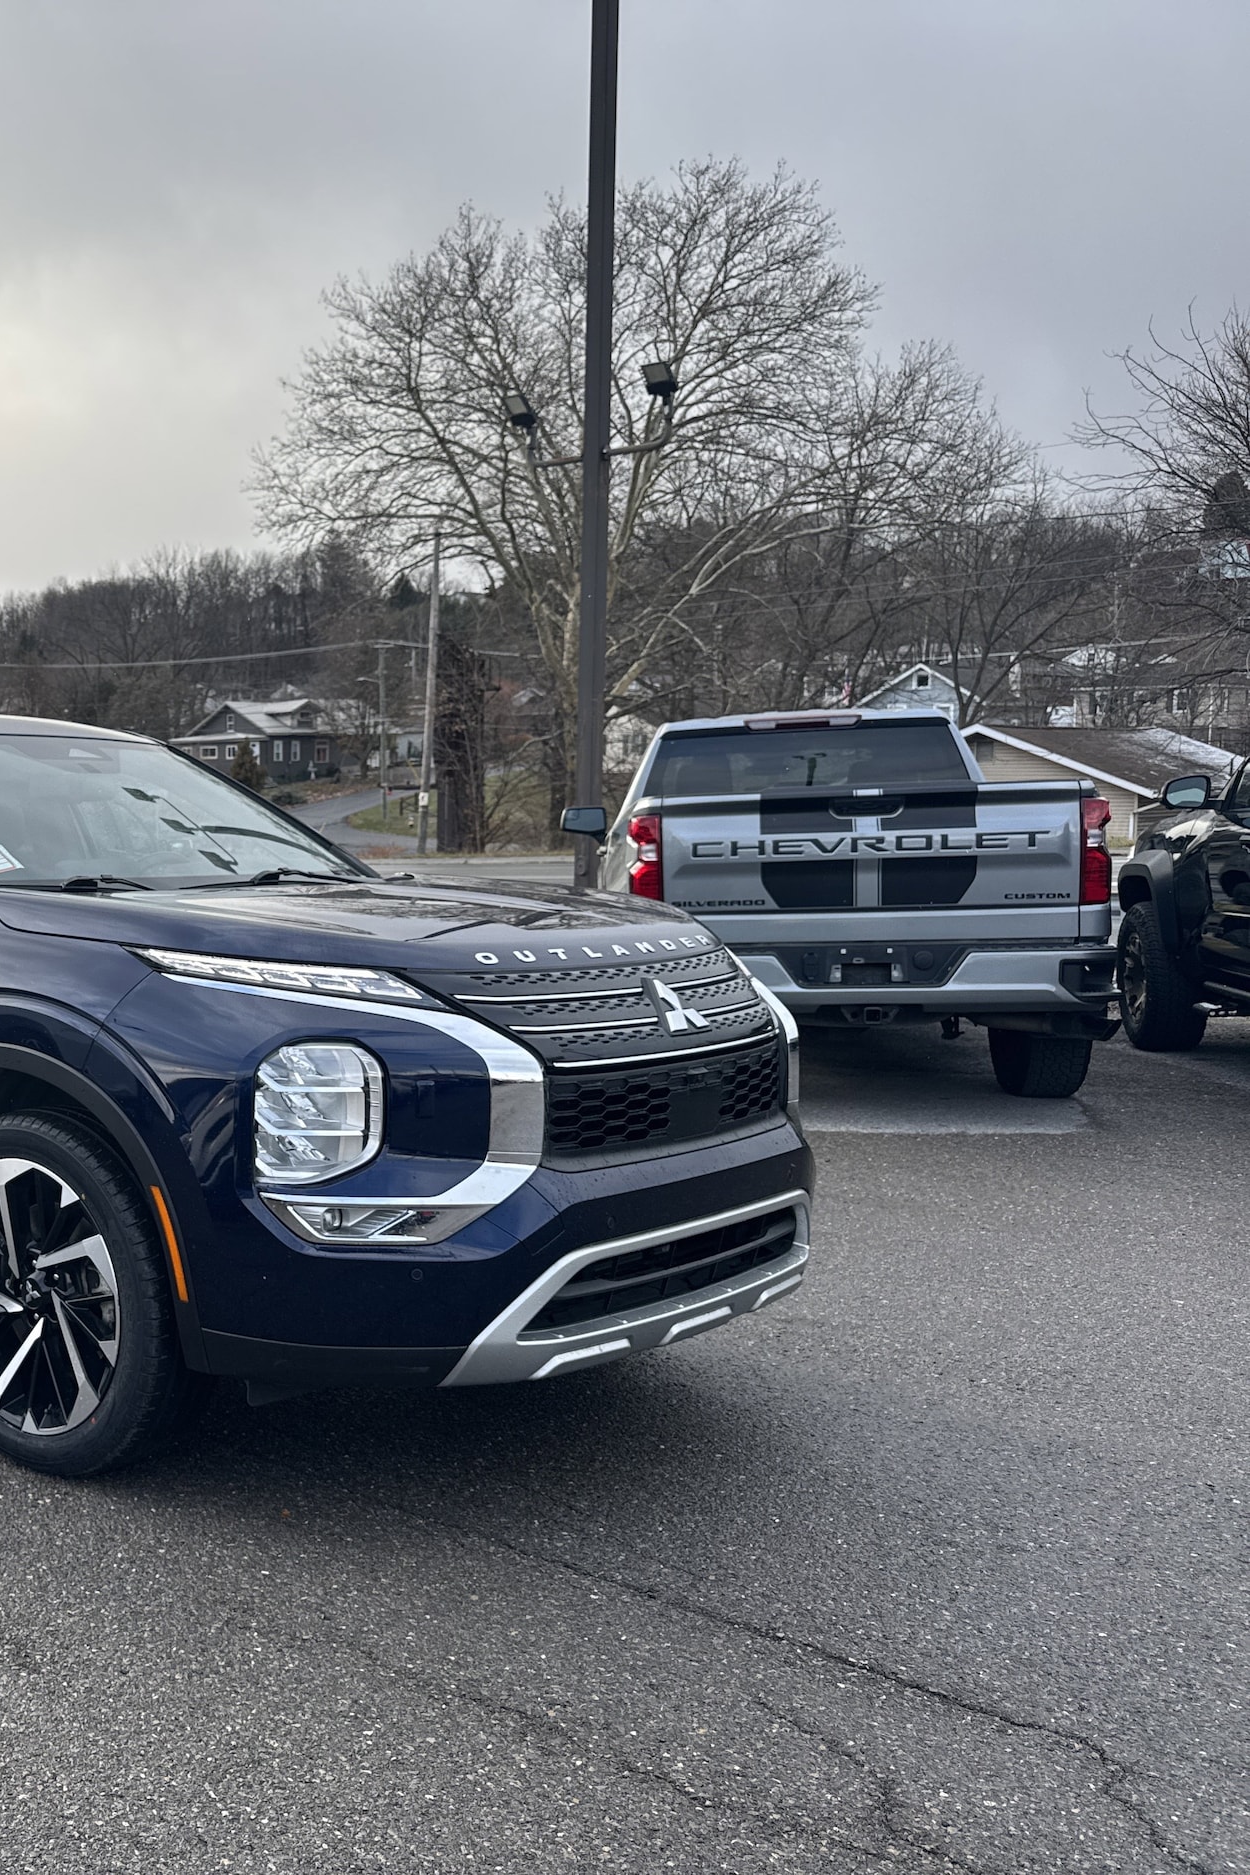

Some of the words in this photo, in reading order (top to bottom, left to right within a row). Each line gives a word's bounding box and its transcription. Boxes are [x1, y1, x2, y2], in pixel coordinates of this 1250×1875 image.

[690, 830, 1051, 859] CHEVROLET
[671, 899, 766, 908] SILVERADO
[474, 934, 712, 965] OUTLANDER
